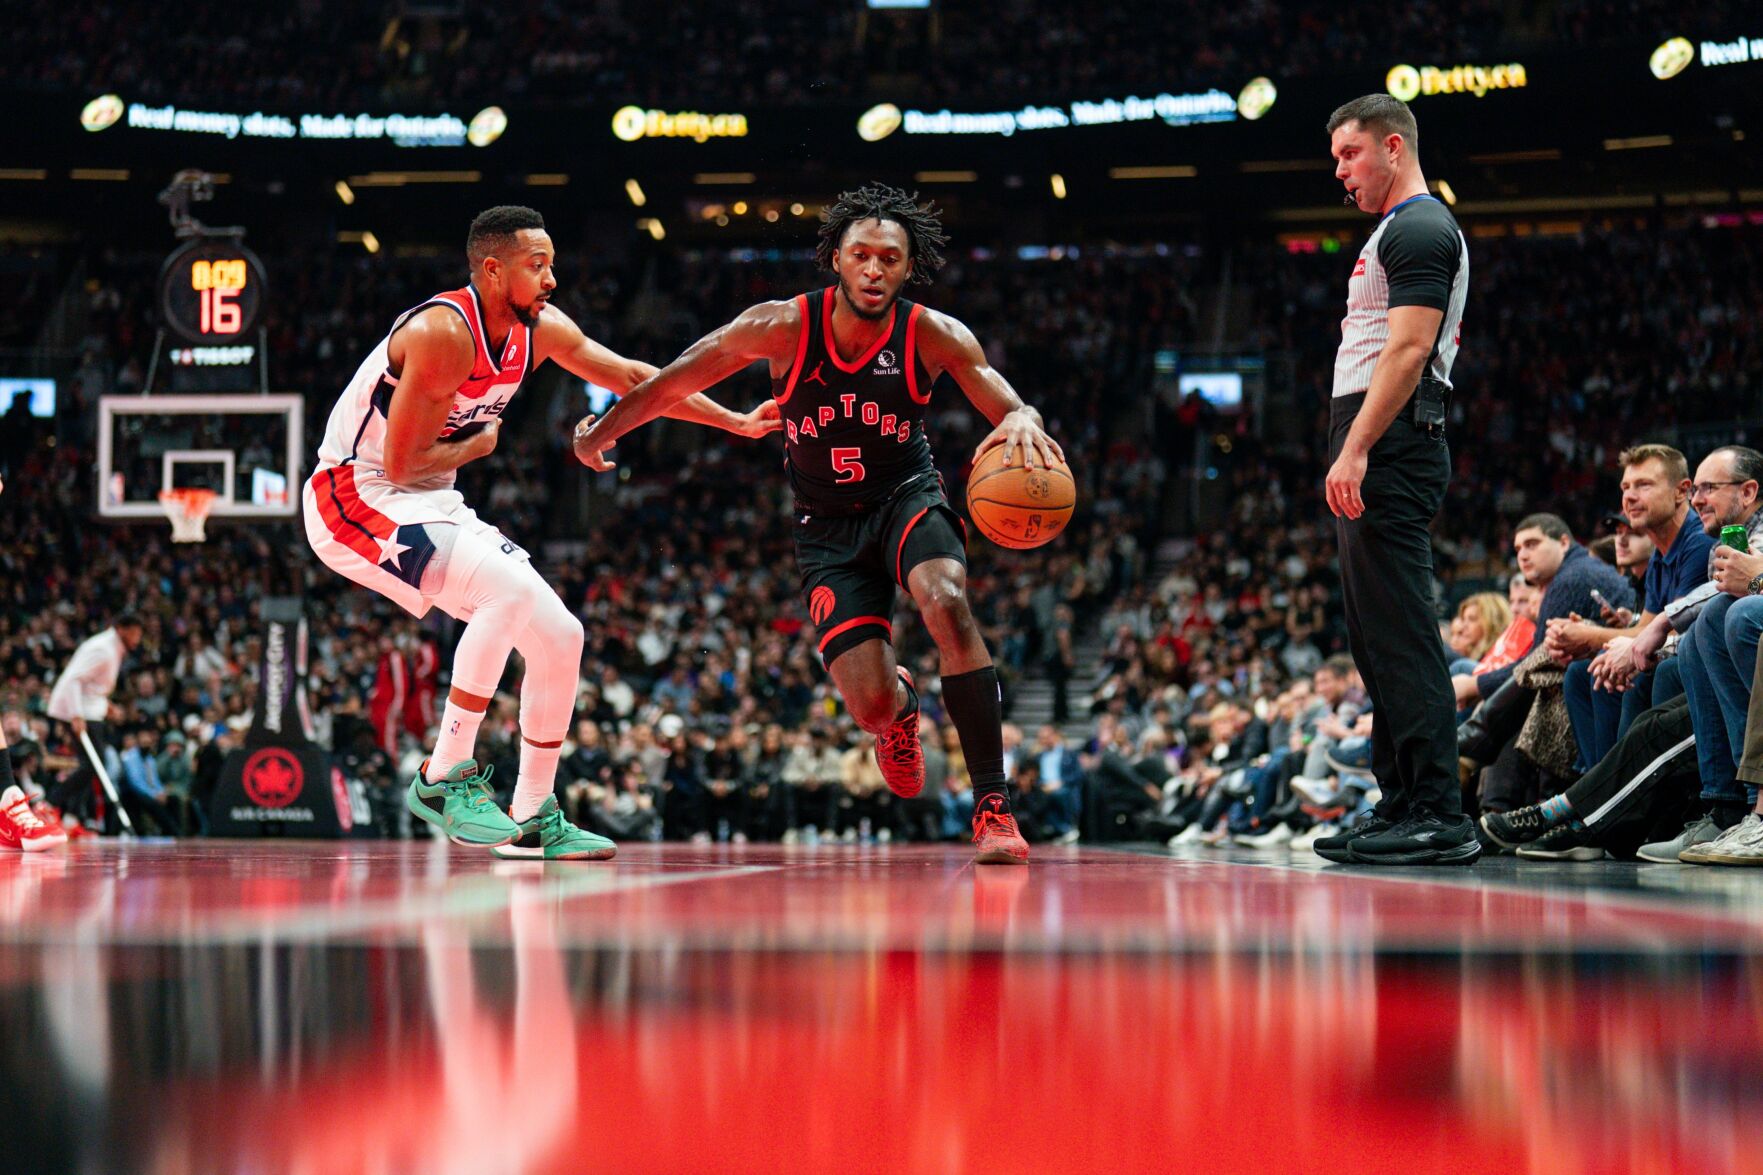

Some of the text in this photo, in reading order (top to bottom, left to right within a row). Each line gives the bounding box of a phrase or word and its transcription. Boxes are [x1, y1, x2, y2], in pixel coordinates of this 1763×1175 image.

[201, 288, 242, 333] 16
[887, 367, 901, 375] Life
[787, 393, 911, 444] RAPTORS
[831, 447, 866, 483] 5
